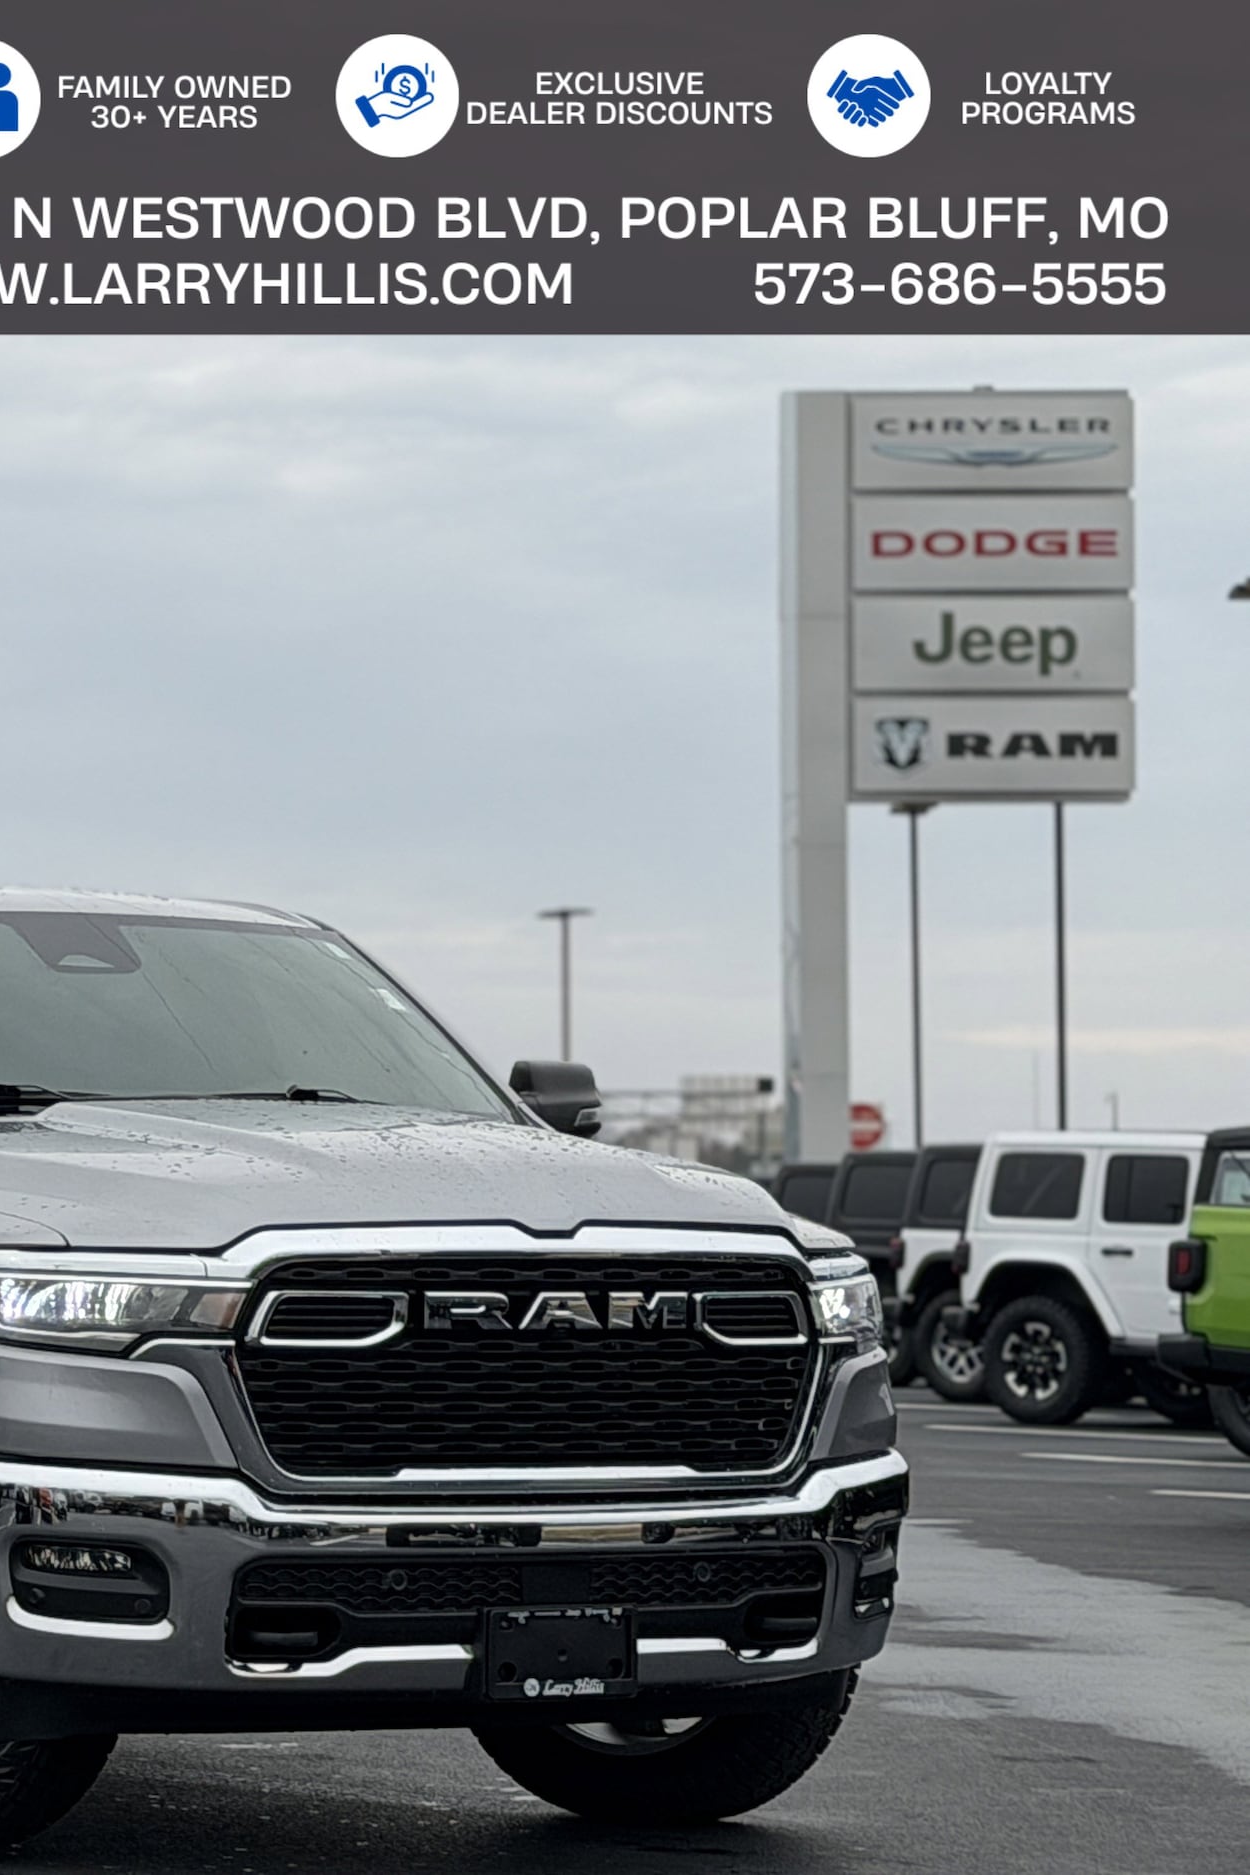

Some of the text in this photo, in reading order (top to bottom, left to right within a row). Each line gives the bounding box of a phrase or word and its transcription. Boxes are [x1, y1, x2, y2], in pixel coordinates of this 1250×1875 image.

[875, 418, 1111, 435] CHRYSLER
[871, 530, 1119, 557] DODGE
[913, 612, 1078, 677] Jeep
[947, 733, 1119, 759] RAM
[424, 1291, 688, 1330] RAM
